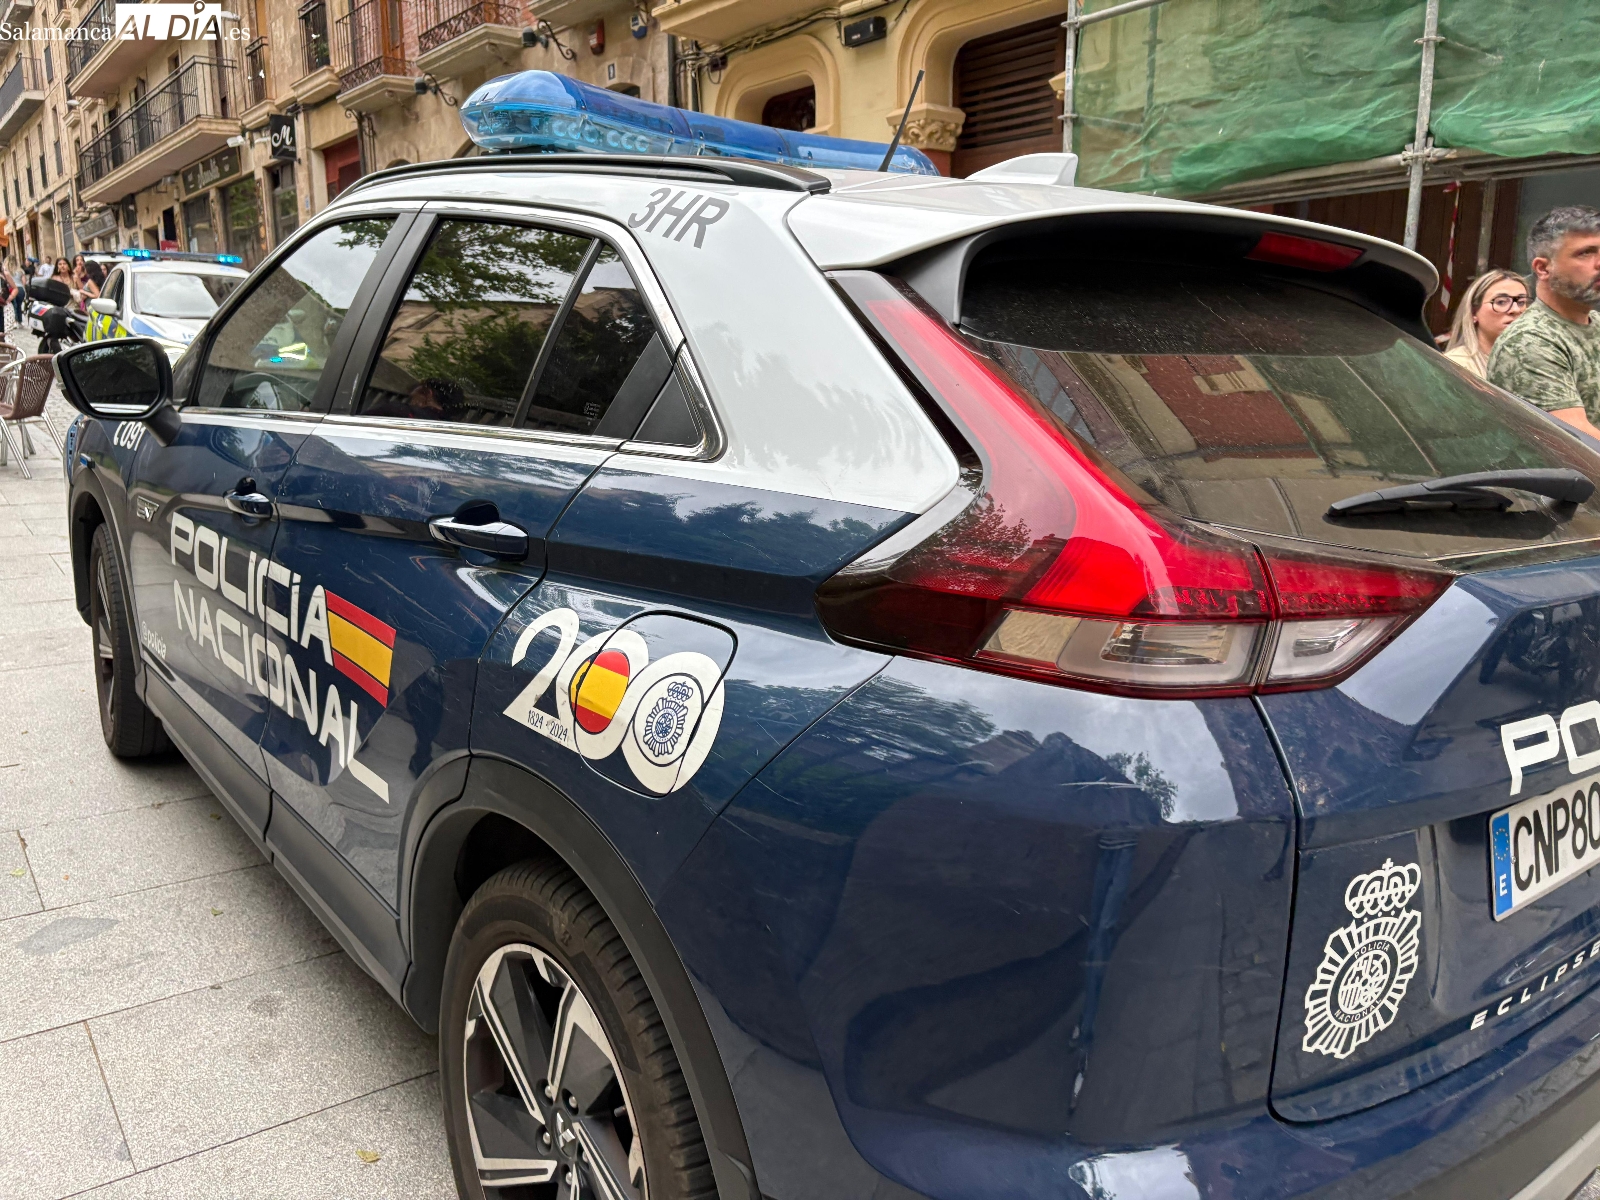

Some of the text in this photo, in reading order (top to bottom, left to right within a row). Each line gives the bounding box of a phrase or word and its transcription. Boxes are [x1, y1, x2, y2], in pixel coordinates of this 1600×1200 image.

[628, 187, 730, 249] 3HR
[173, 579, 390, 804] NACIONAL
[502, 607, 725, 794] 200
[527, 709, 568, 742] 1824 2024
[1499, 873, 1508, 897] E
[1333, 998, 1383, 1024] NACIONAL
[1470, 940, 1600, 1031] ECLIPSE
